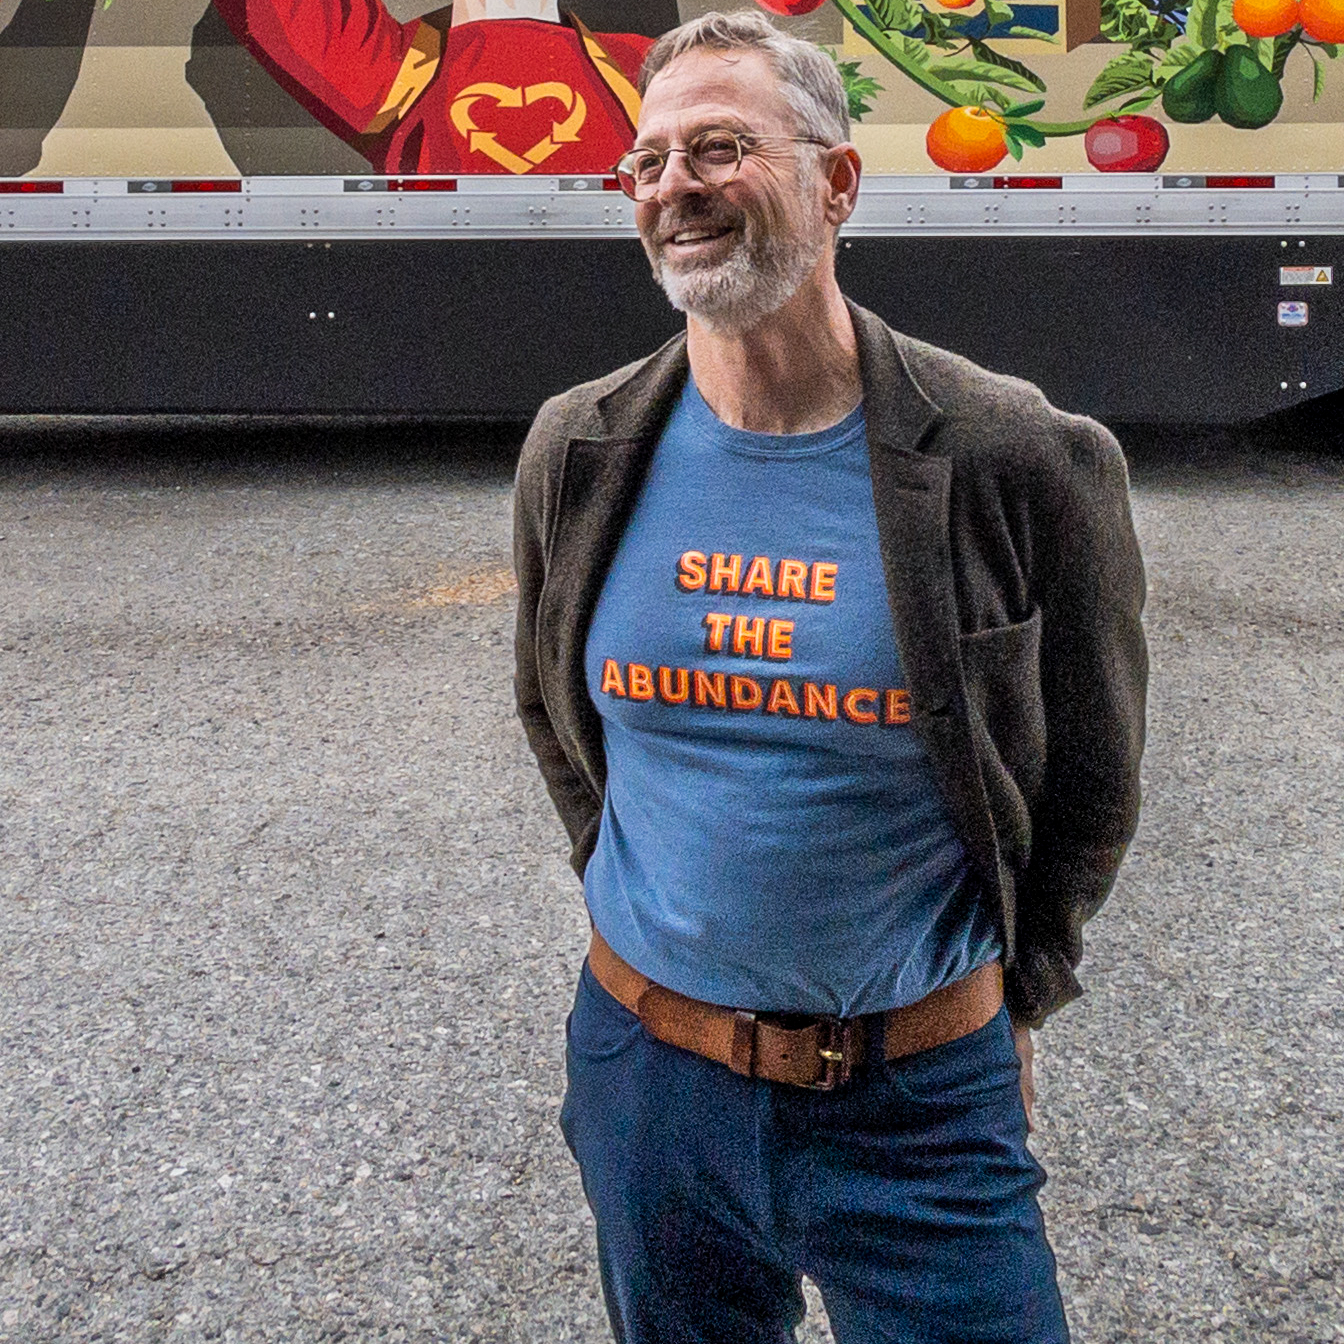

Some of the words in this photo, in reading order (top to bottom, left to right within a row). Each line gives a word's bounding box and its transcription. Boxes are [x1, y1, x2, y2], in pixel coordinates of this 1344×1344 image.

[678, 549, 840, 604] SHARE
[703, 611, 796, 660] THE
[601, 658, 913, 726] ABUNDANCE
